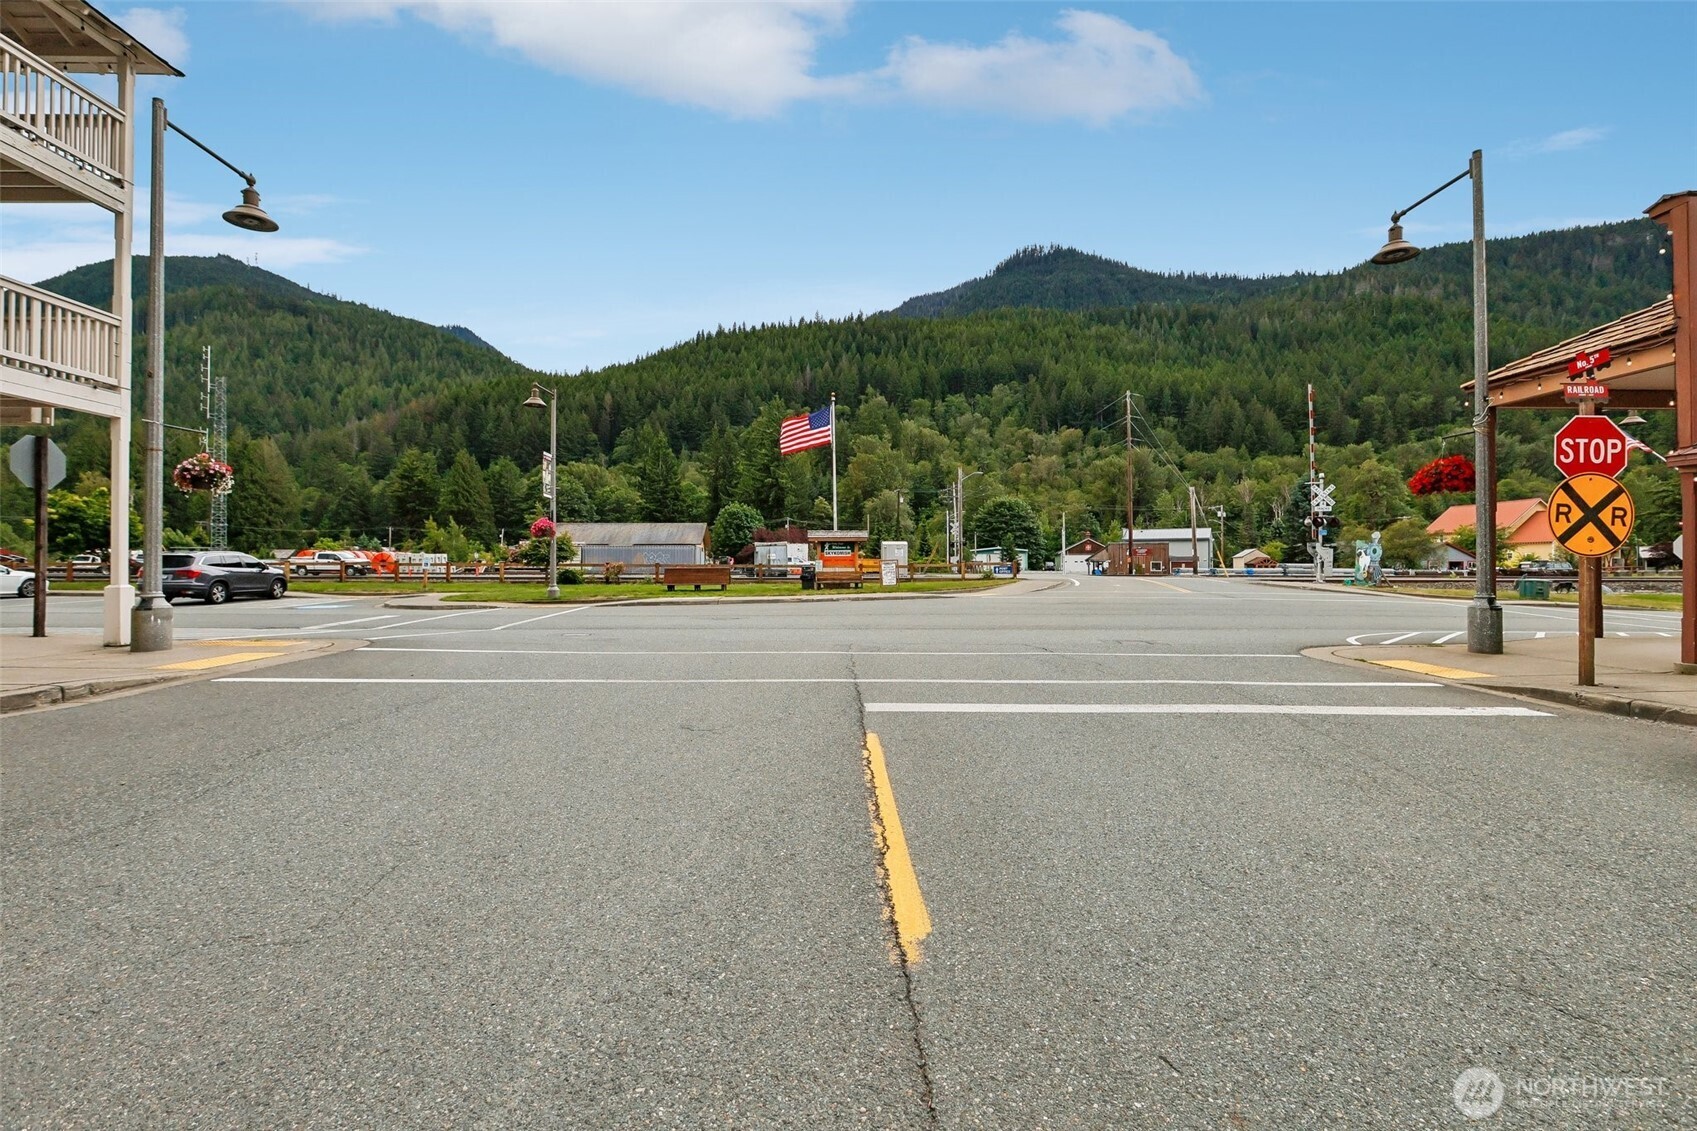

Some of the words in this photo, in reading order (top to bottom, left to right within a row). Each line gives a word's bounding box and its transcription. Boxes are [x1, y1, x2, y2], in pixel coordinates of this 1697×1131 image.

[1577, 360, 1589, 369] No.
[1567, 385, 1604, 394] RAILROAD
[1559, 438, 1622, 464] STOP
[1555, 503, 1572, 523] R
[1611, 506, 1627, 527] R
